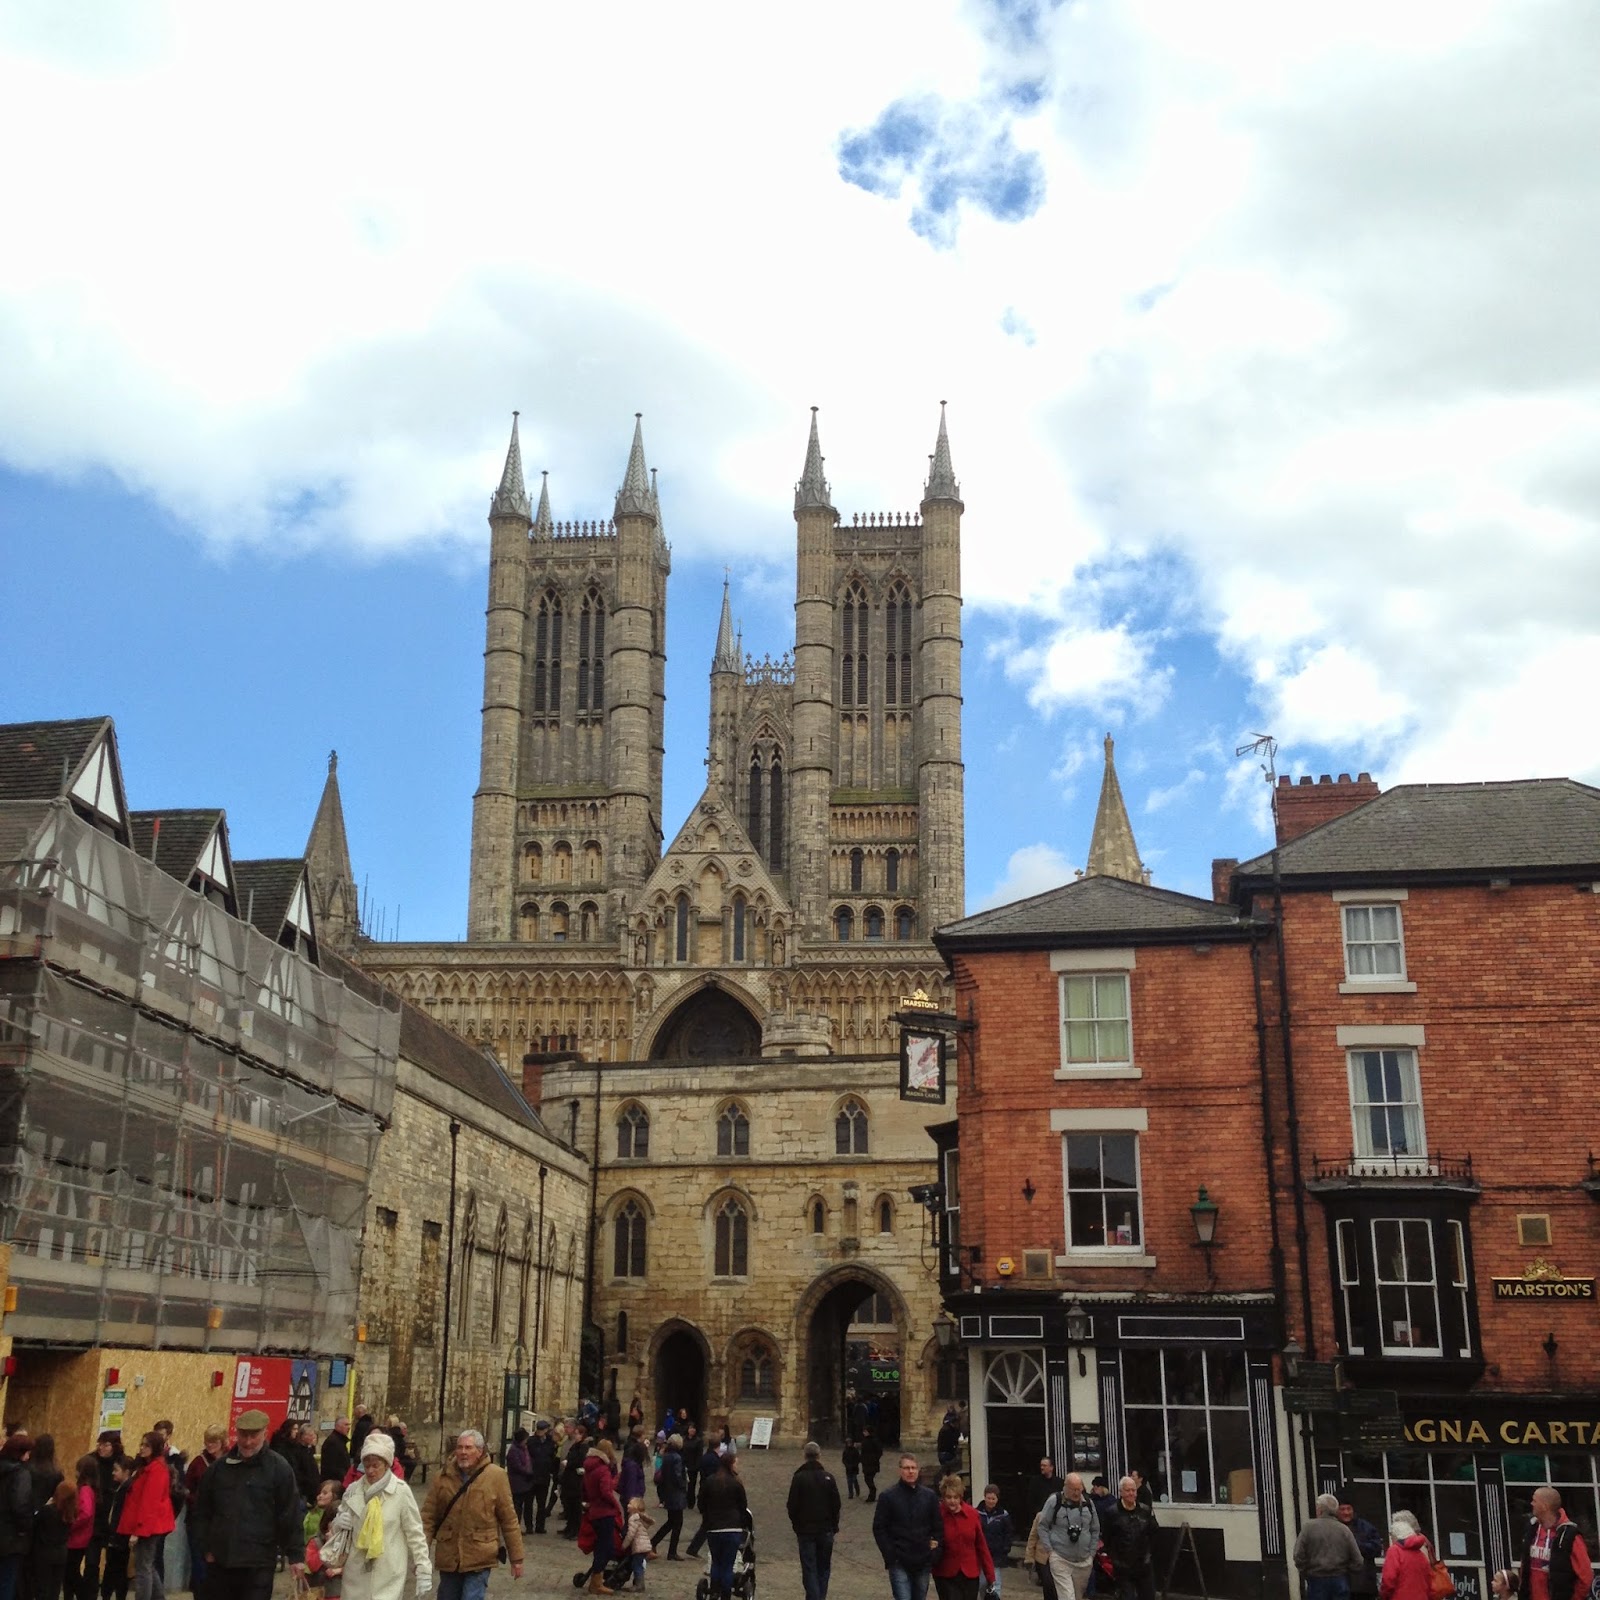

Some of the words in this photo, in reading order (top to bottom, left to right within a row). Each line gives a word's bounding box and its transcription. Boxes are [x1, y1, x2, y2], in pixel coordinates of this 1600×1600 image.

[903, 999, 939, 1010] MARSTON'S
[1498, 1282, 1592, 1297] MARSTON'S
[870, 1368, 891, 1379] Tour
[1404, 1419, 1491, 1444] AGNA
